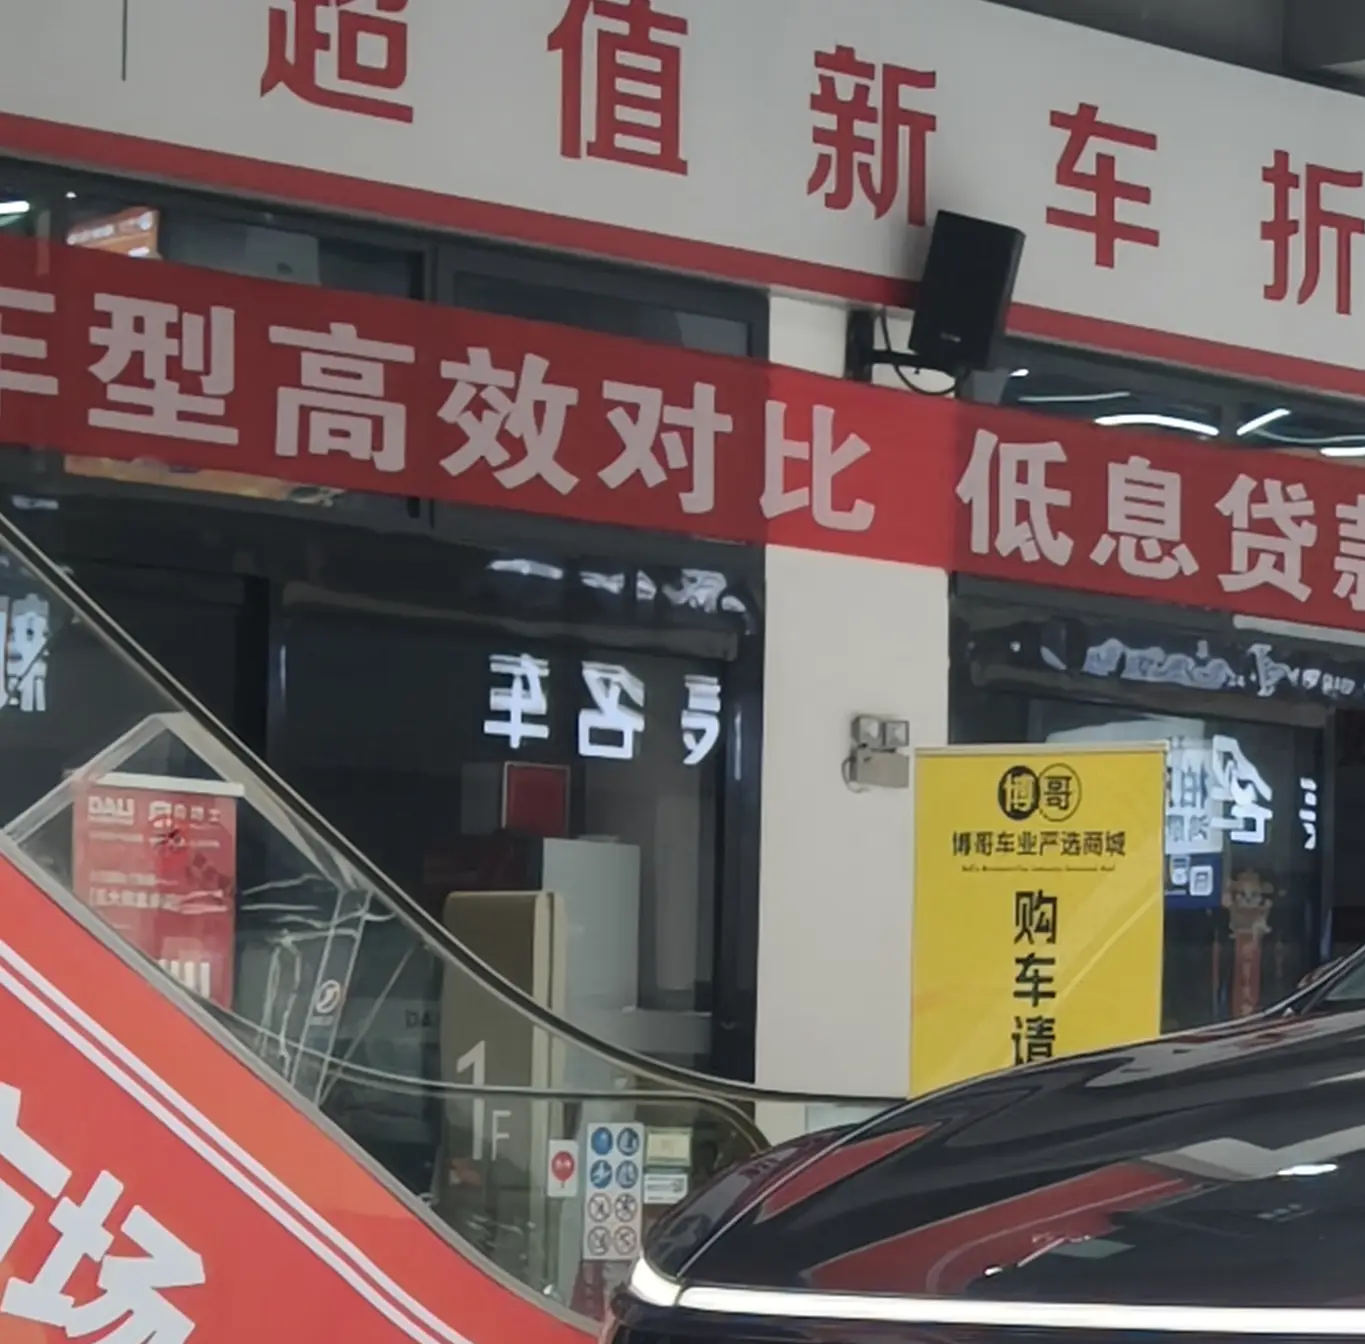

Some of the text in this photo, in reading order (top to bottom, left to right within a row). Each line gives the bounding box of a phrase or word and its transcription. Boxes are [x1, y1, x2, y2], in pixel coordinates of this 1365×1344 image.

[952, 830, 1127, 857] 博哥车业严选商城
[1011, 889, 1058, 1067] 购车请
